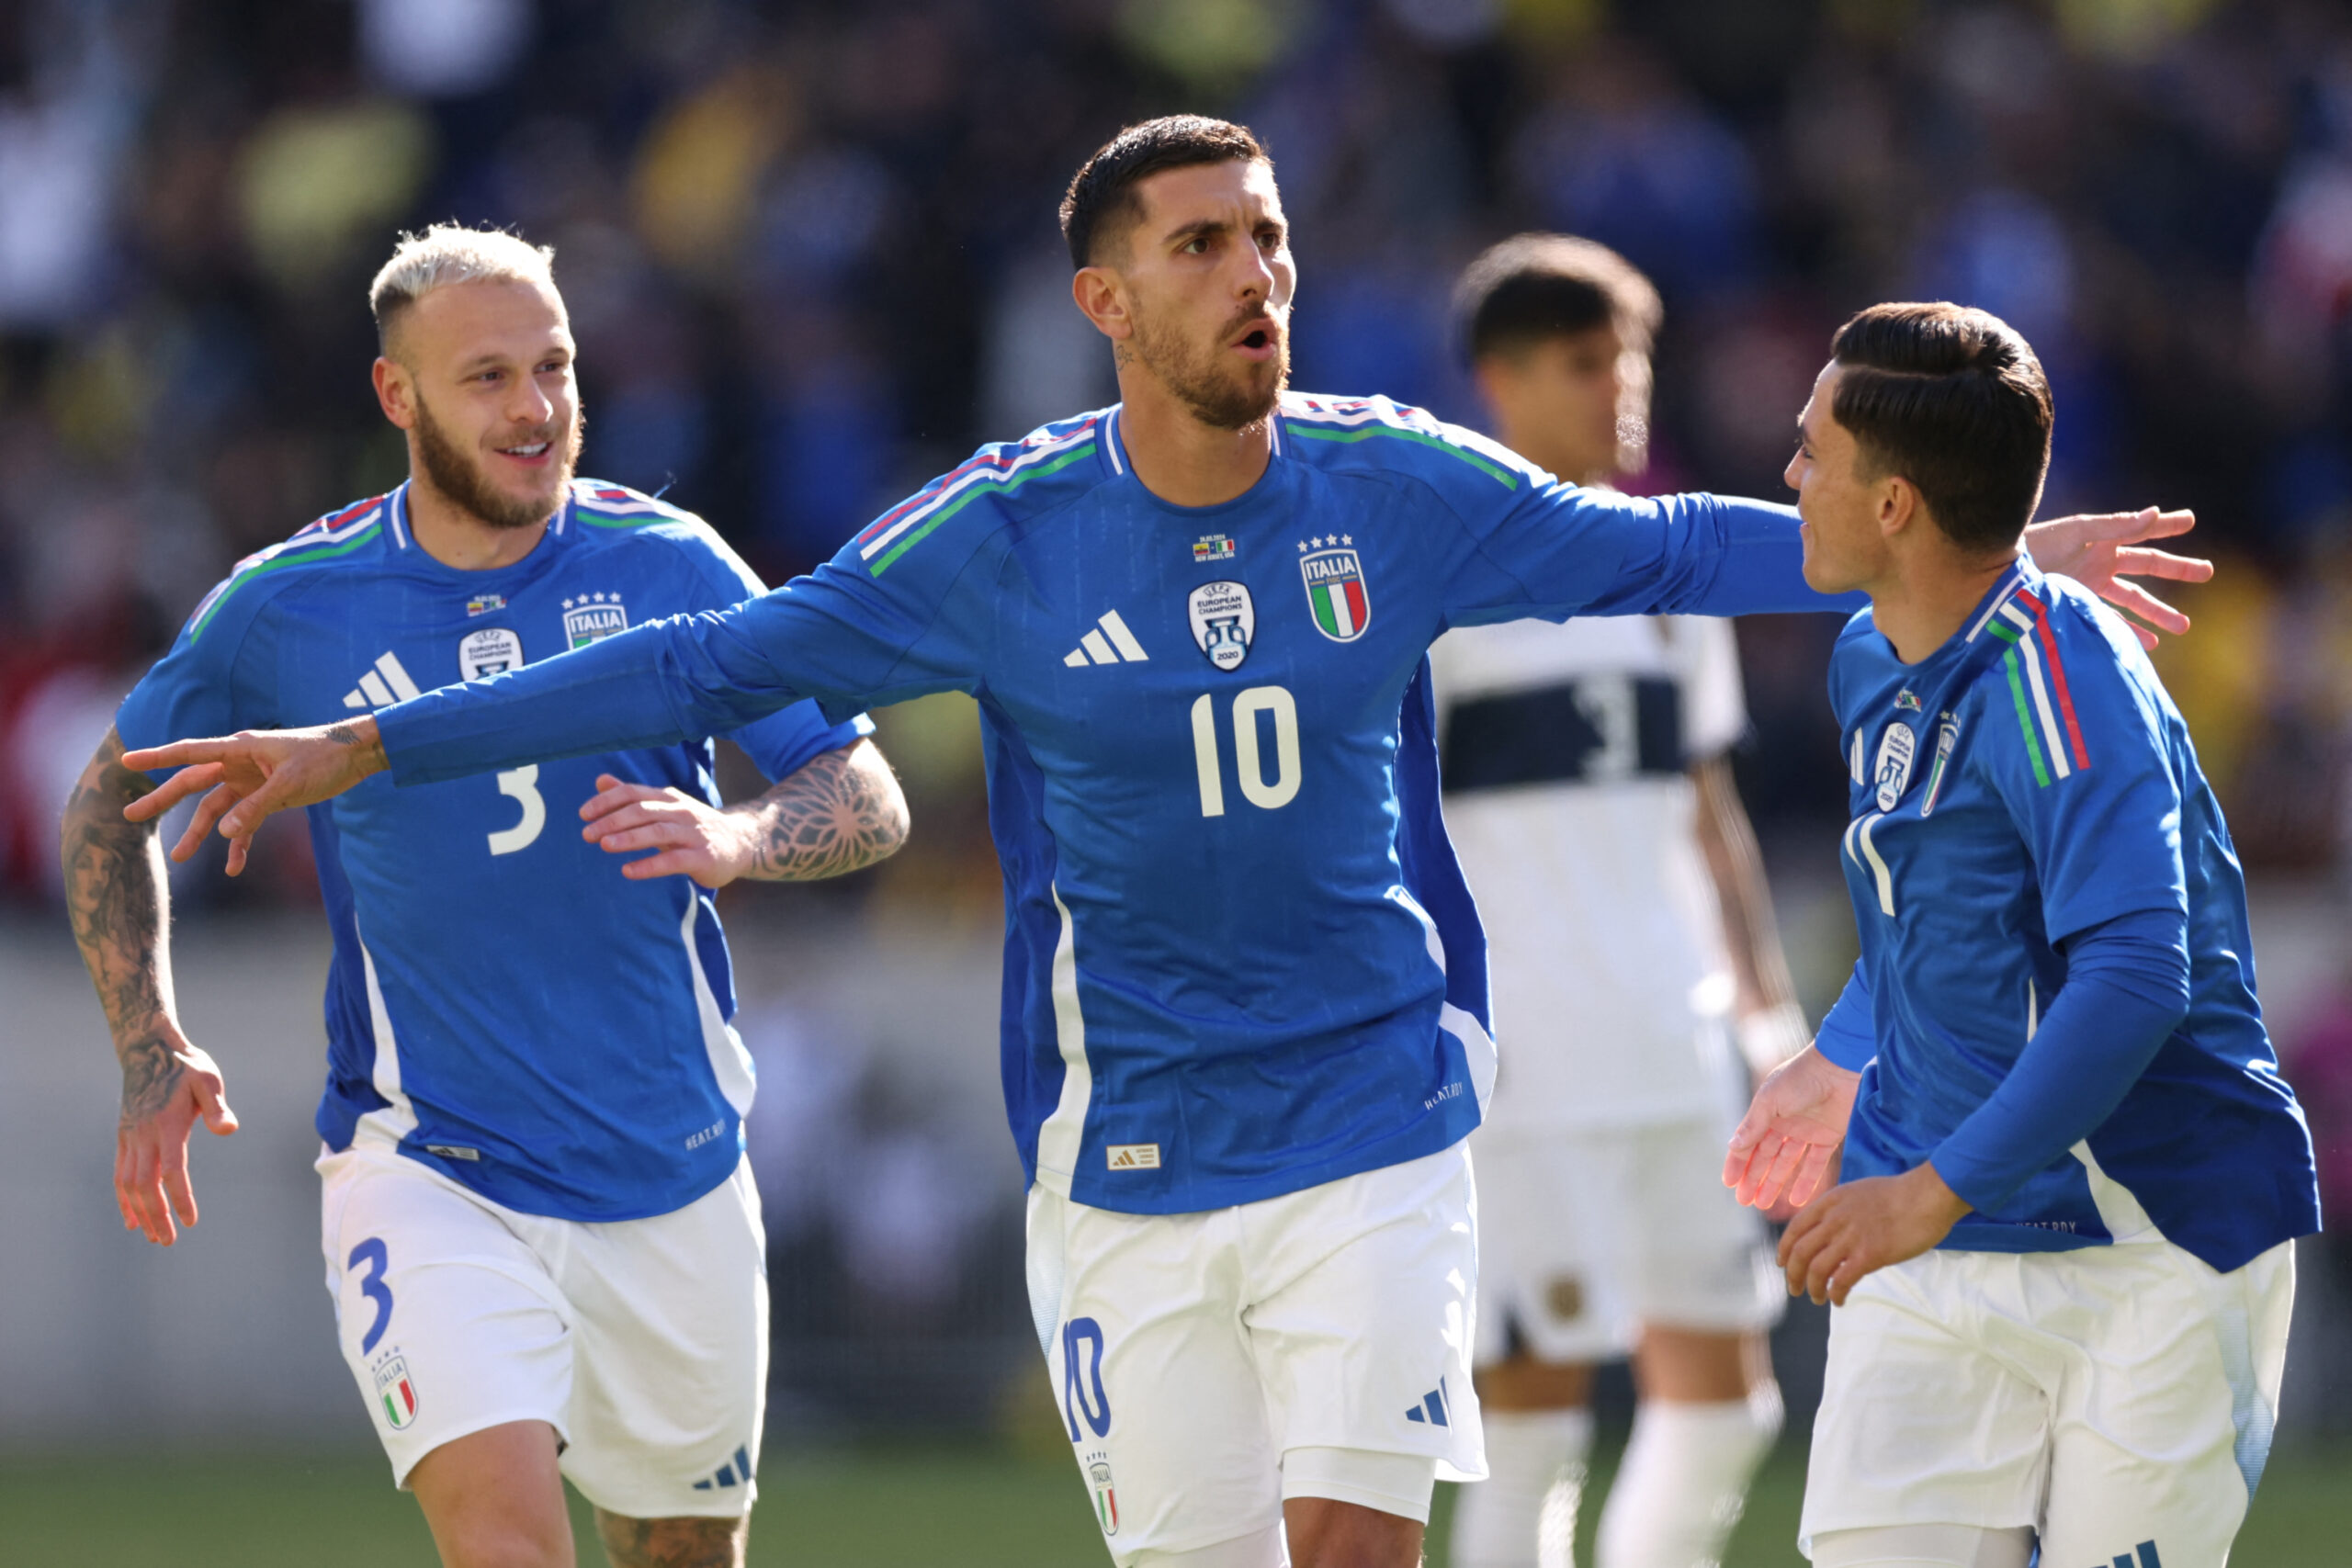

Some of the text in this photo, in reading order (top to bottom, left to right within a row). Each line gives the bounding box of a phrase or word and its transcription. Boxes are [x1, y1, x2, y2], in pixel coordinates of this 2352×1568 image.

[1306, 557, 1355, 580] ITALIA
[1204, 583, 1231, 596] UEFA
[1197, 595, 1242, 608] EUROPEAN
[1198, 604, 1242, 615] CHAMPIONS
[570, 611, 622, 633] ITALIA
[474, 629, 501, 642] UEFA
[468, 642, 512, 654] EUROPEAN
[469, 649, 513, 660] CHAMPIONS
[1216, 650, 1239, 660] 2020
[1191, 685, 1302, 817] 10
[488, 763, 546, 856] 3
[347, 1236, 393, 1357] 3
[378, 1363, 402, 1389] ITALIA
[1062, 1316, 1111, 1443] 10
[1093, 1470, 1111, 1484] ITALIA
